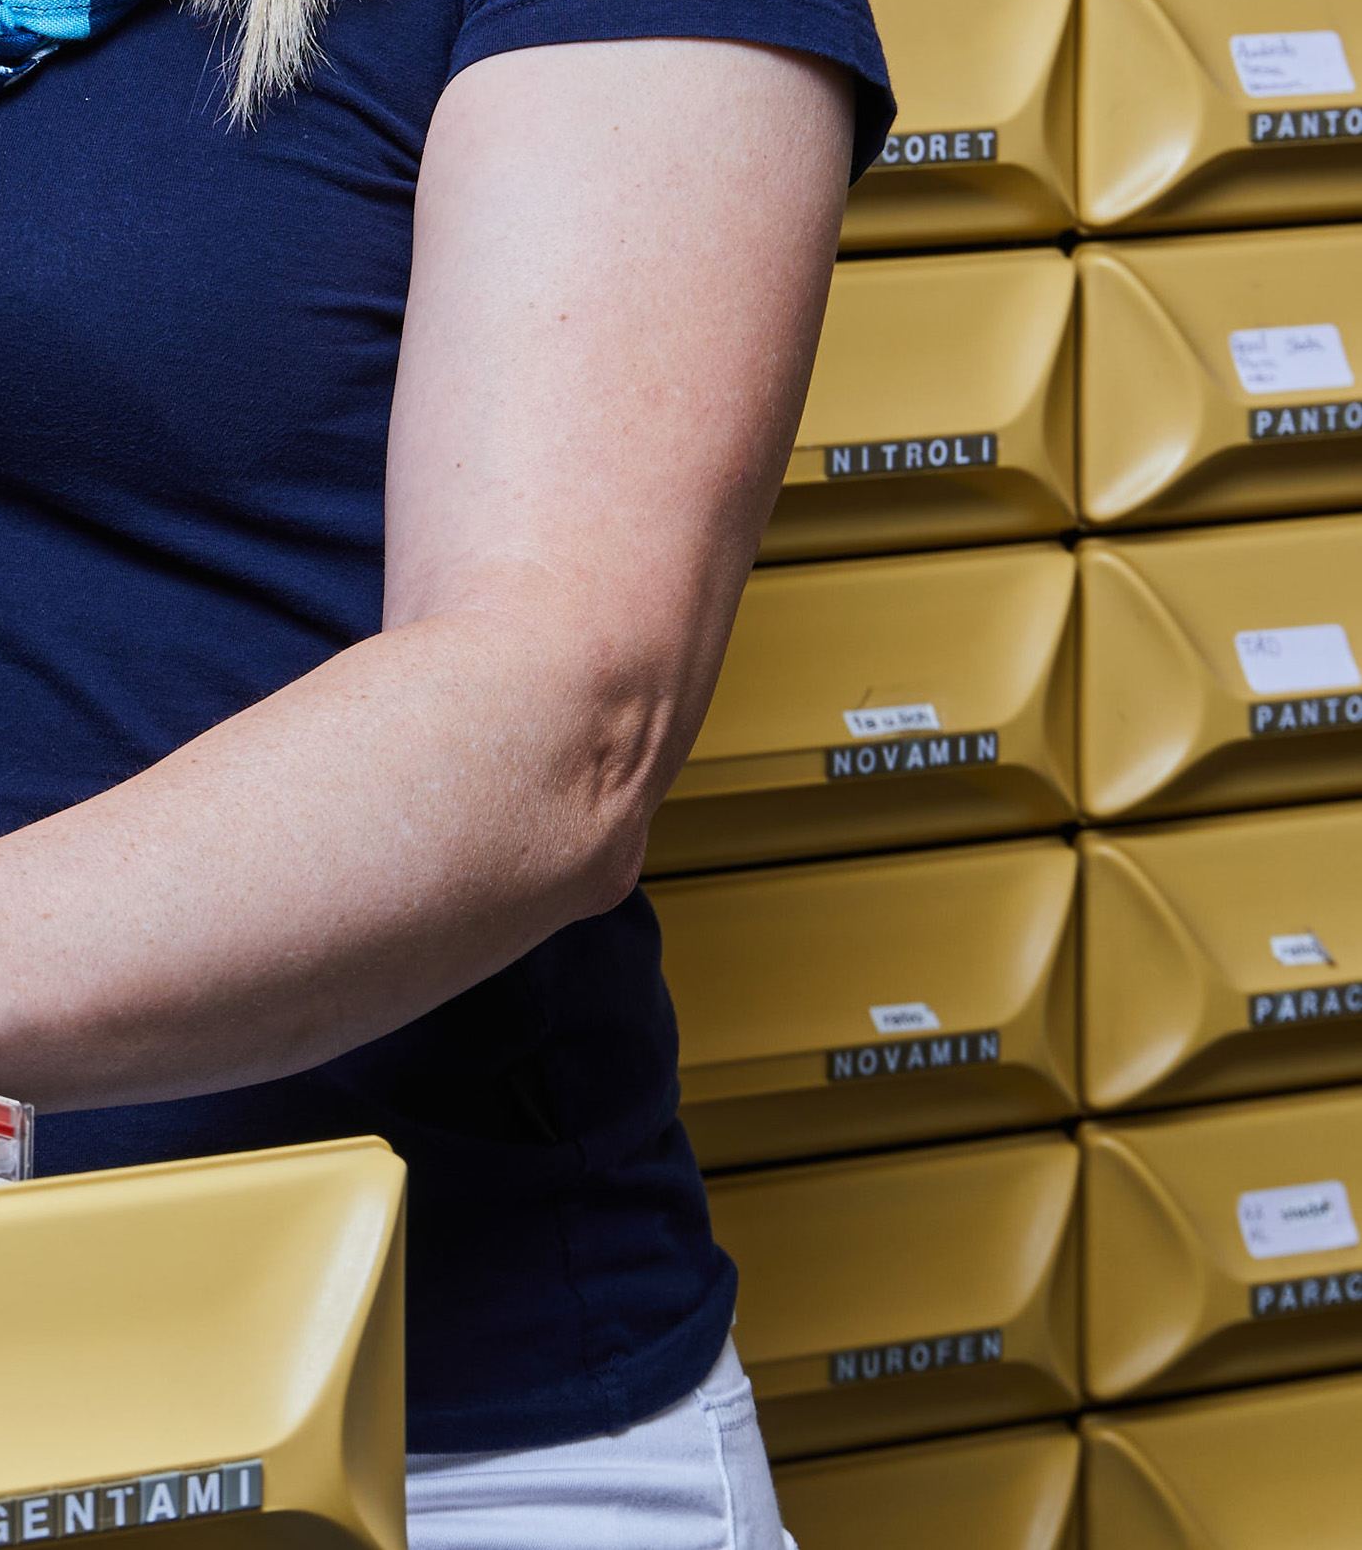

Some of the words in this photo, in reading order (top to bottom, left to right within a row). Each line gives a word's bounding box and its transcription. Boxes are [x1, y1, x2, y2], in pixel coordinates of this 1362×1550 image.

[1256, 108, 1362, 139] PANTO
[1256, 403, 1362, 435] PANTO
[832, 437, 992, 473] NITROLI
[1257, 695, 1362, 729] PANTO
[833, 732, 997, 776] NOVAMIN
[834, 1033, 1000, 1078] NOVAMIN
[839, 1336, 1001, 1377] NUROFEN
